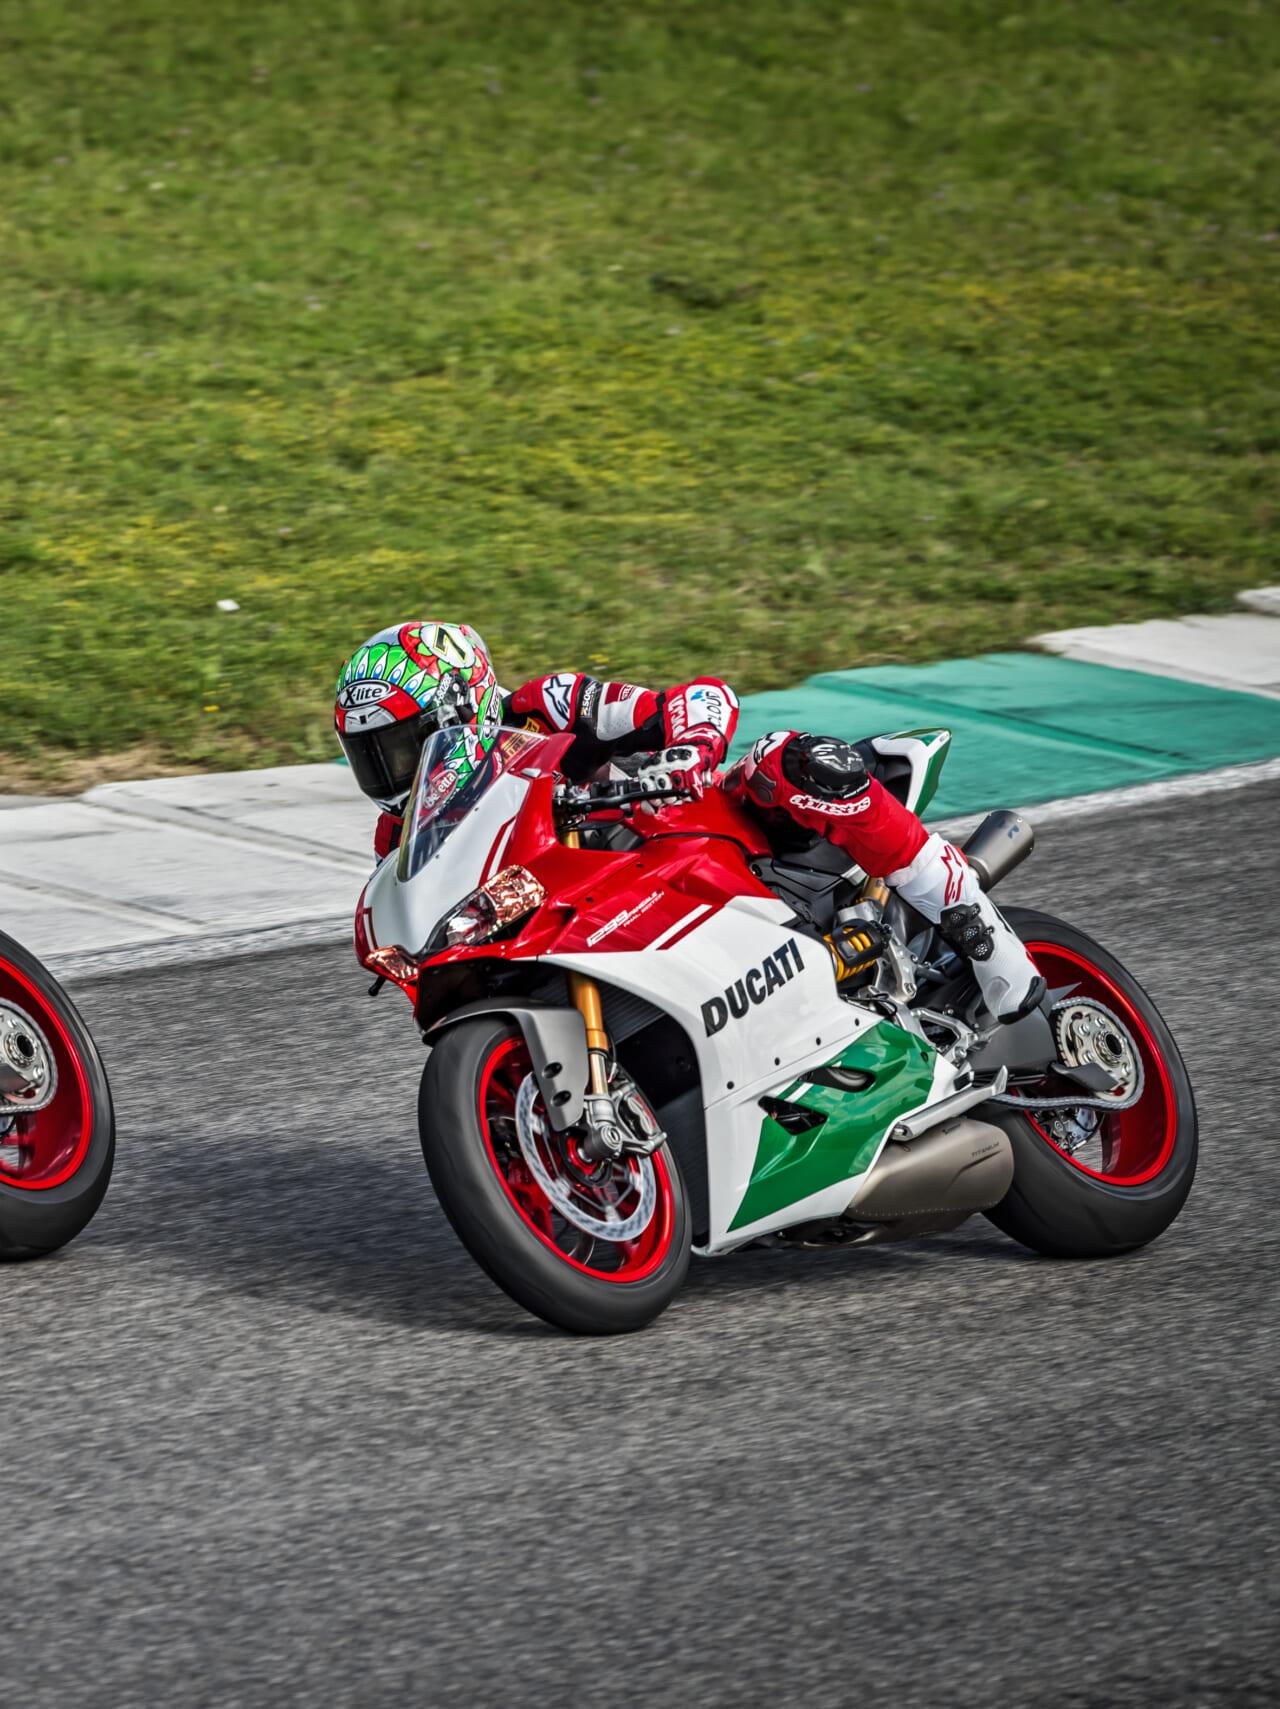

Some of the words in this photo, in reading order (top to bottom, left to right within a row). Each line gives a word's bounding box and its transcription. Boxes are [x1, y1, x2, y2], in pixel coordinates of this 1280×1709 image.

[434, 625, 466, 663] 7
[342, 685, 382, 708] X-lite
[586, 909, 629, 948] 1299
[700, 937, 805, 1038] DUCATI
